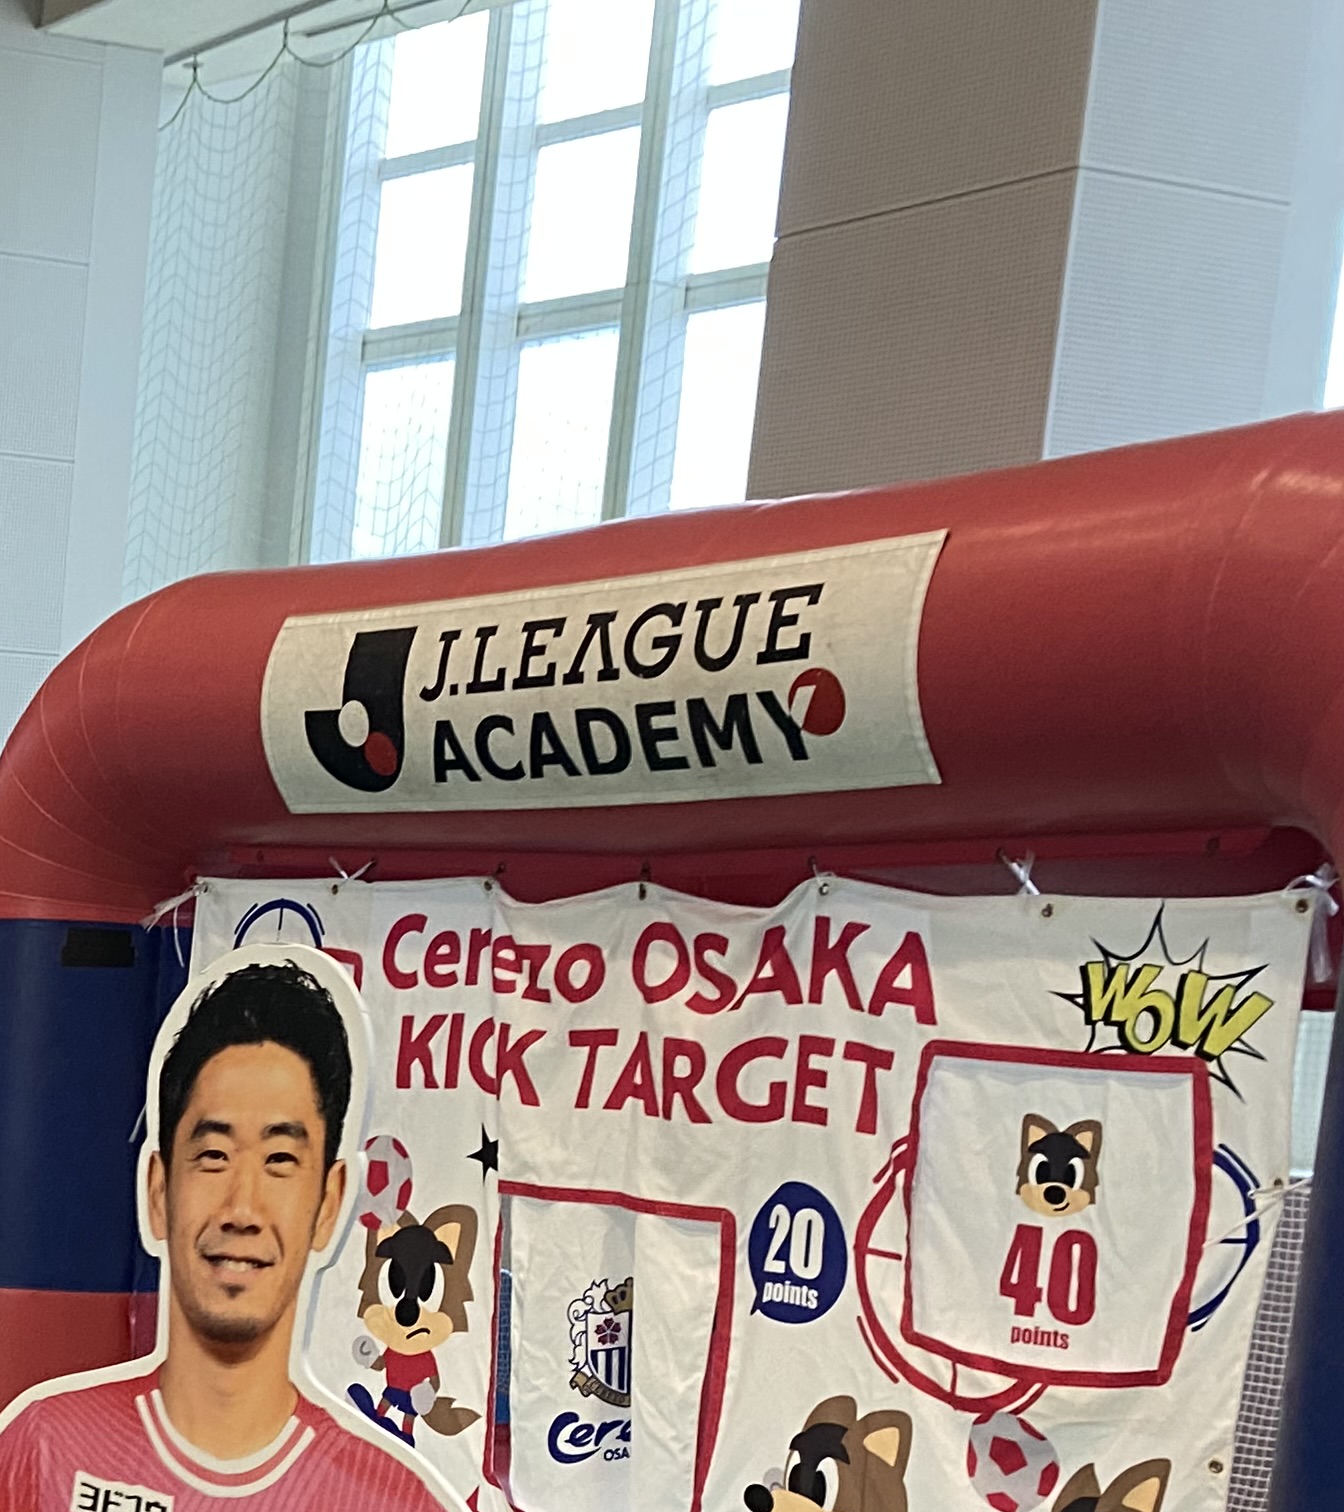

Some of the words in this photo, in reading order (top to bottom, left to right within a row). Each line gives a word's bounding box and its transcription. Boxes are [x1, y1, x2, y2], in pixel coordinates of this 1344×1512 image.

[420, 583, 825, 702] J.LEAGUE
[432, 684, 817, 784] ACADEMY
[382, 913, 605, 1004] Cerezo
[631, 915, 938, 1026] OSAKA
[396, 1012, 548, 1107] KICK
[569, 1029, 895, 1135] TARGET
[763, 1203, 826, 1280] 20
[999, 1224, 1098, 1326] 40
[762, 1281, 819, 1309] points
[1010, 1326, 1070, 1350] points
